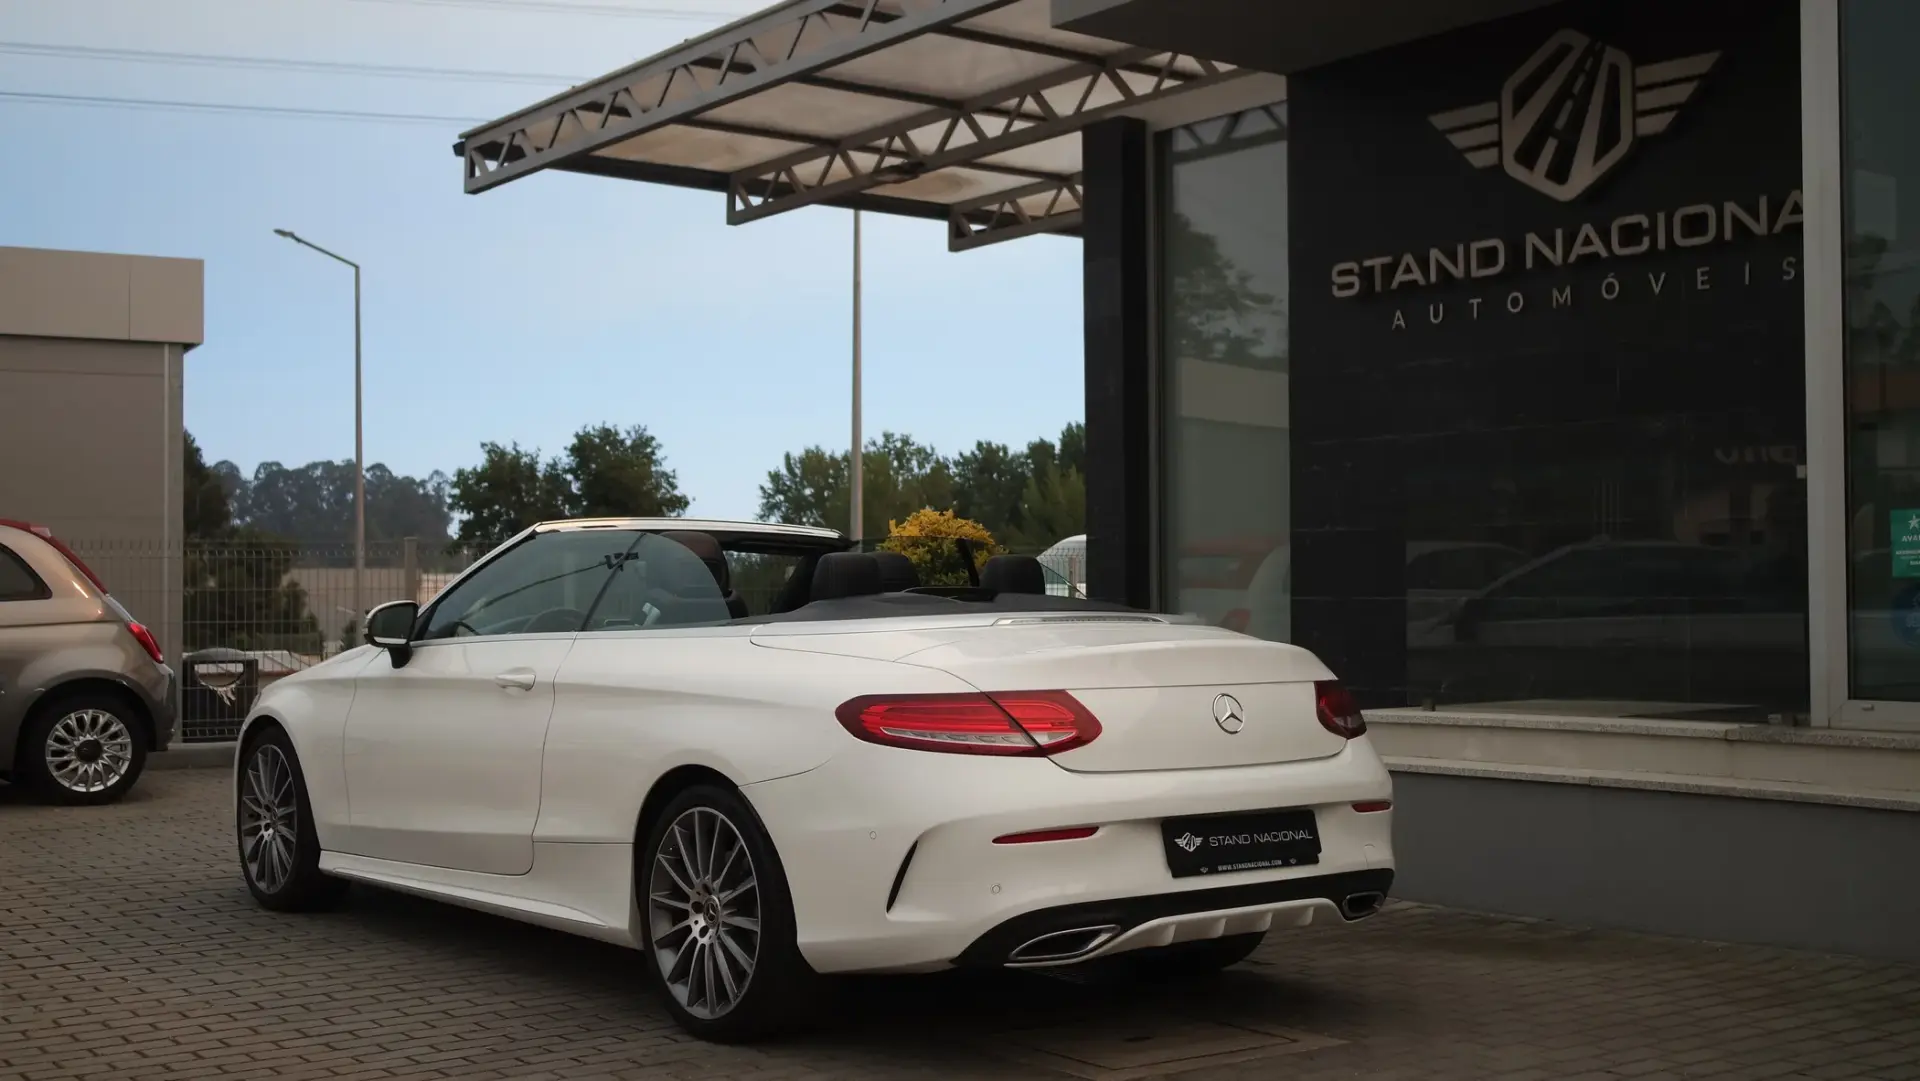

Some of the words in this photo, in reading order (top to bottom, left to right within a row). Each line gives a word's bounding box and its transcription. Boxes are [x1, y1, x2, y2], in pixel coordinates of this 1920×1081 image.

[1331, 237, 1506, 299] STAND
[1391, 256, 1797, 331] AUTOMÓVEIS
[1209, 834, 1251, 847] STAND
[1254, 829, 1313, 844] NACIONAL
[1218, 860, 1282, 872] WWW.STANDNACIONAL.COM
